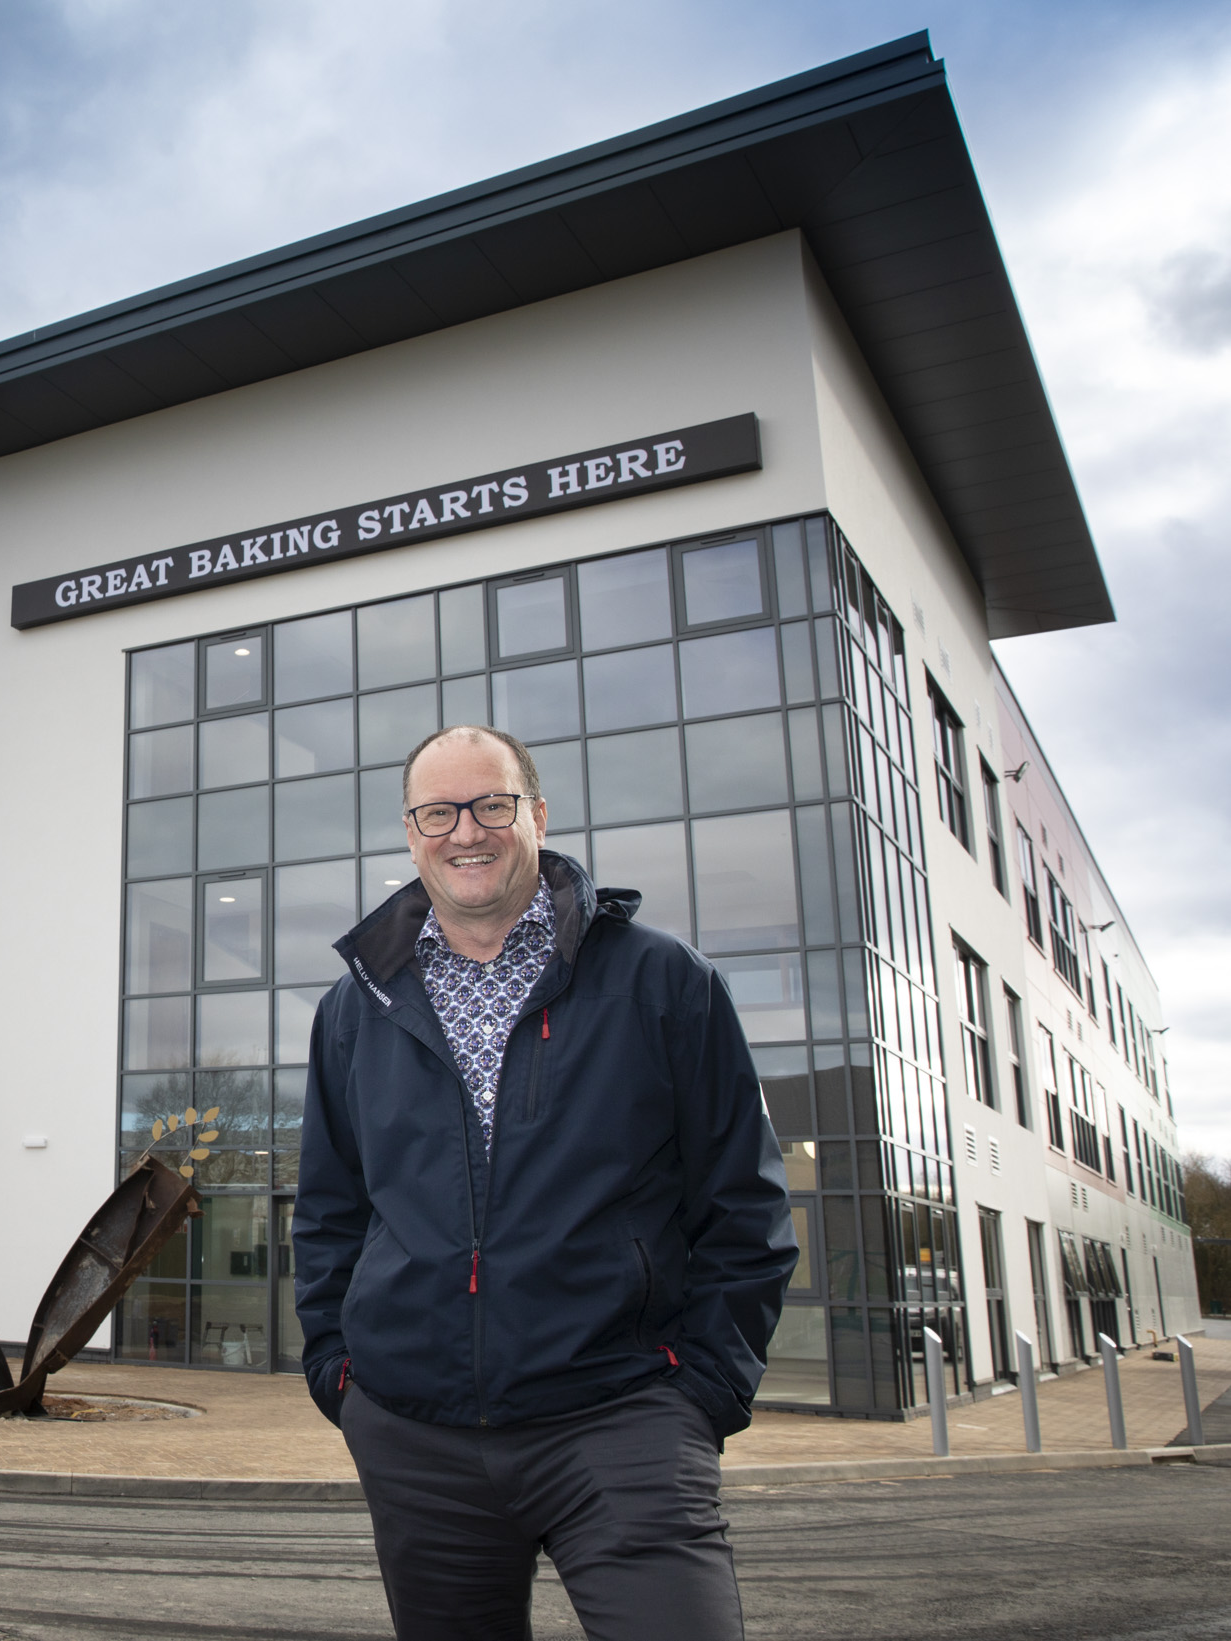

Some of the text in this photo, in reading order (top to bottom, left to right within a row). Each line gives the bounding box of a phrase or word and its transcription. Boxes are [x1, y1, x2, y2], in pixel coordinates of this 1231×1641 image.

[55, 439, 686, 607] GREAT BAKING STARTS HERE
[353, 956, 392, 1007] HELLY HANSEN
